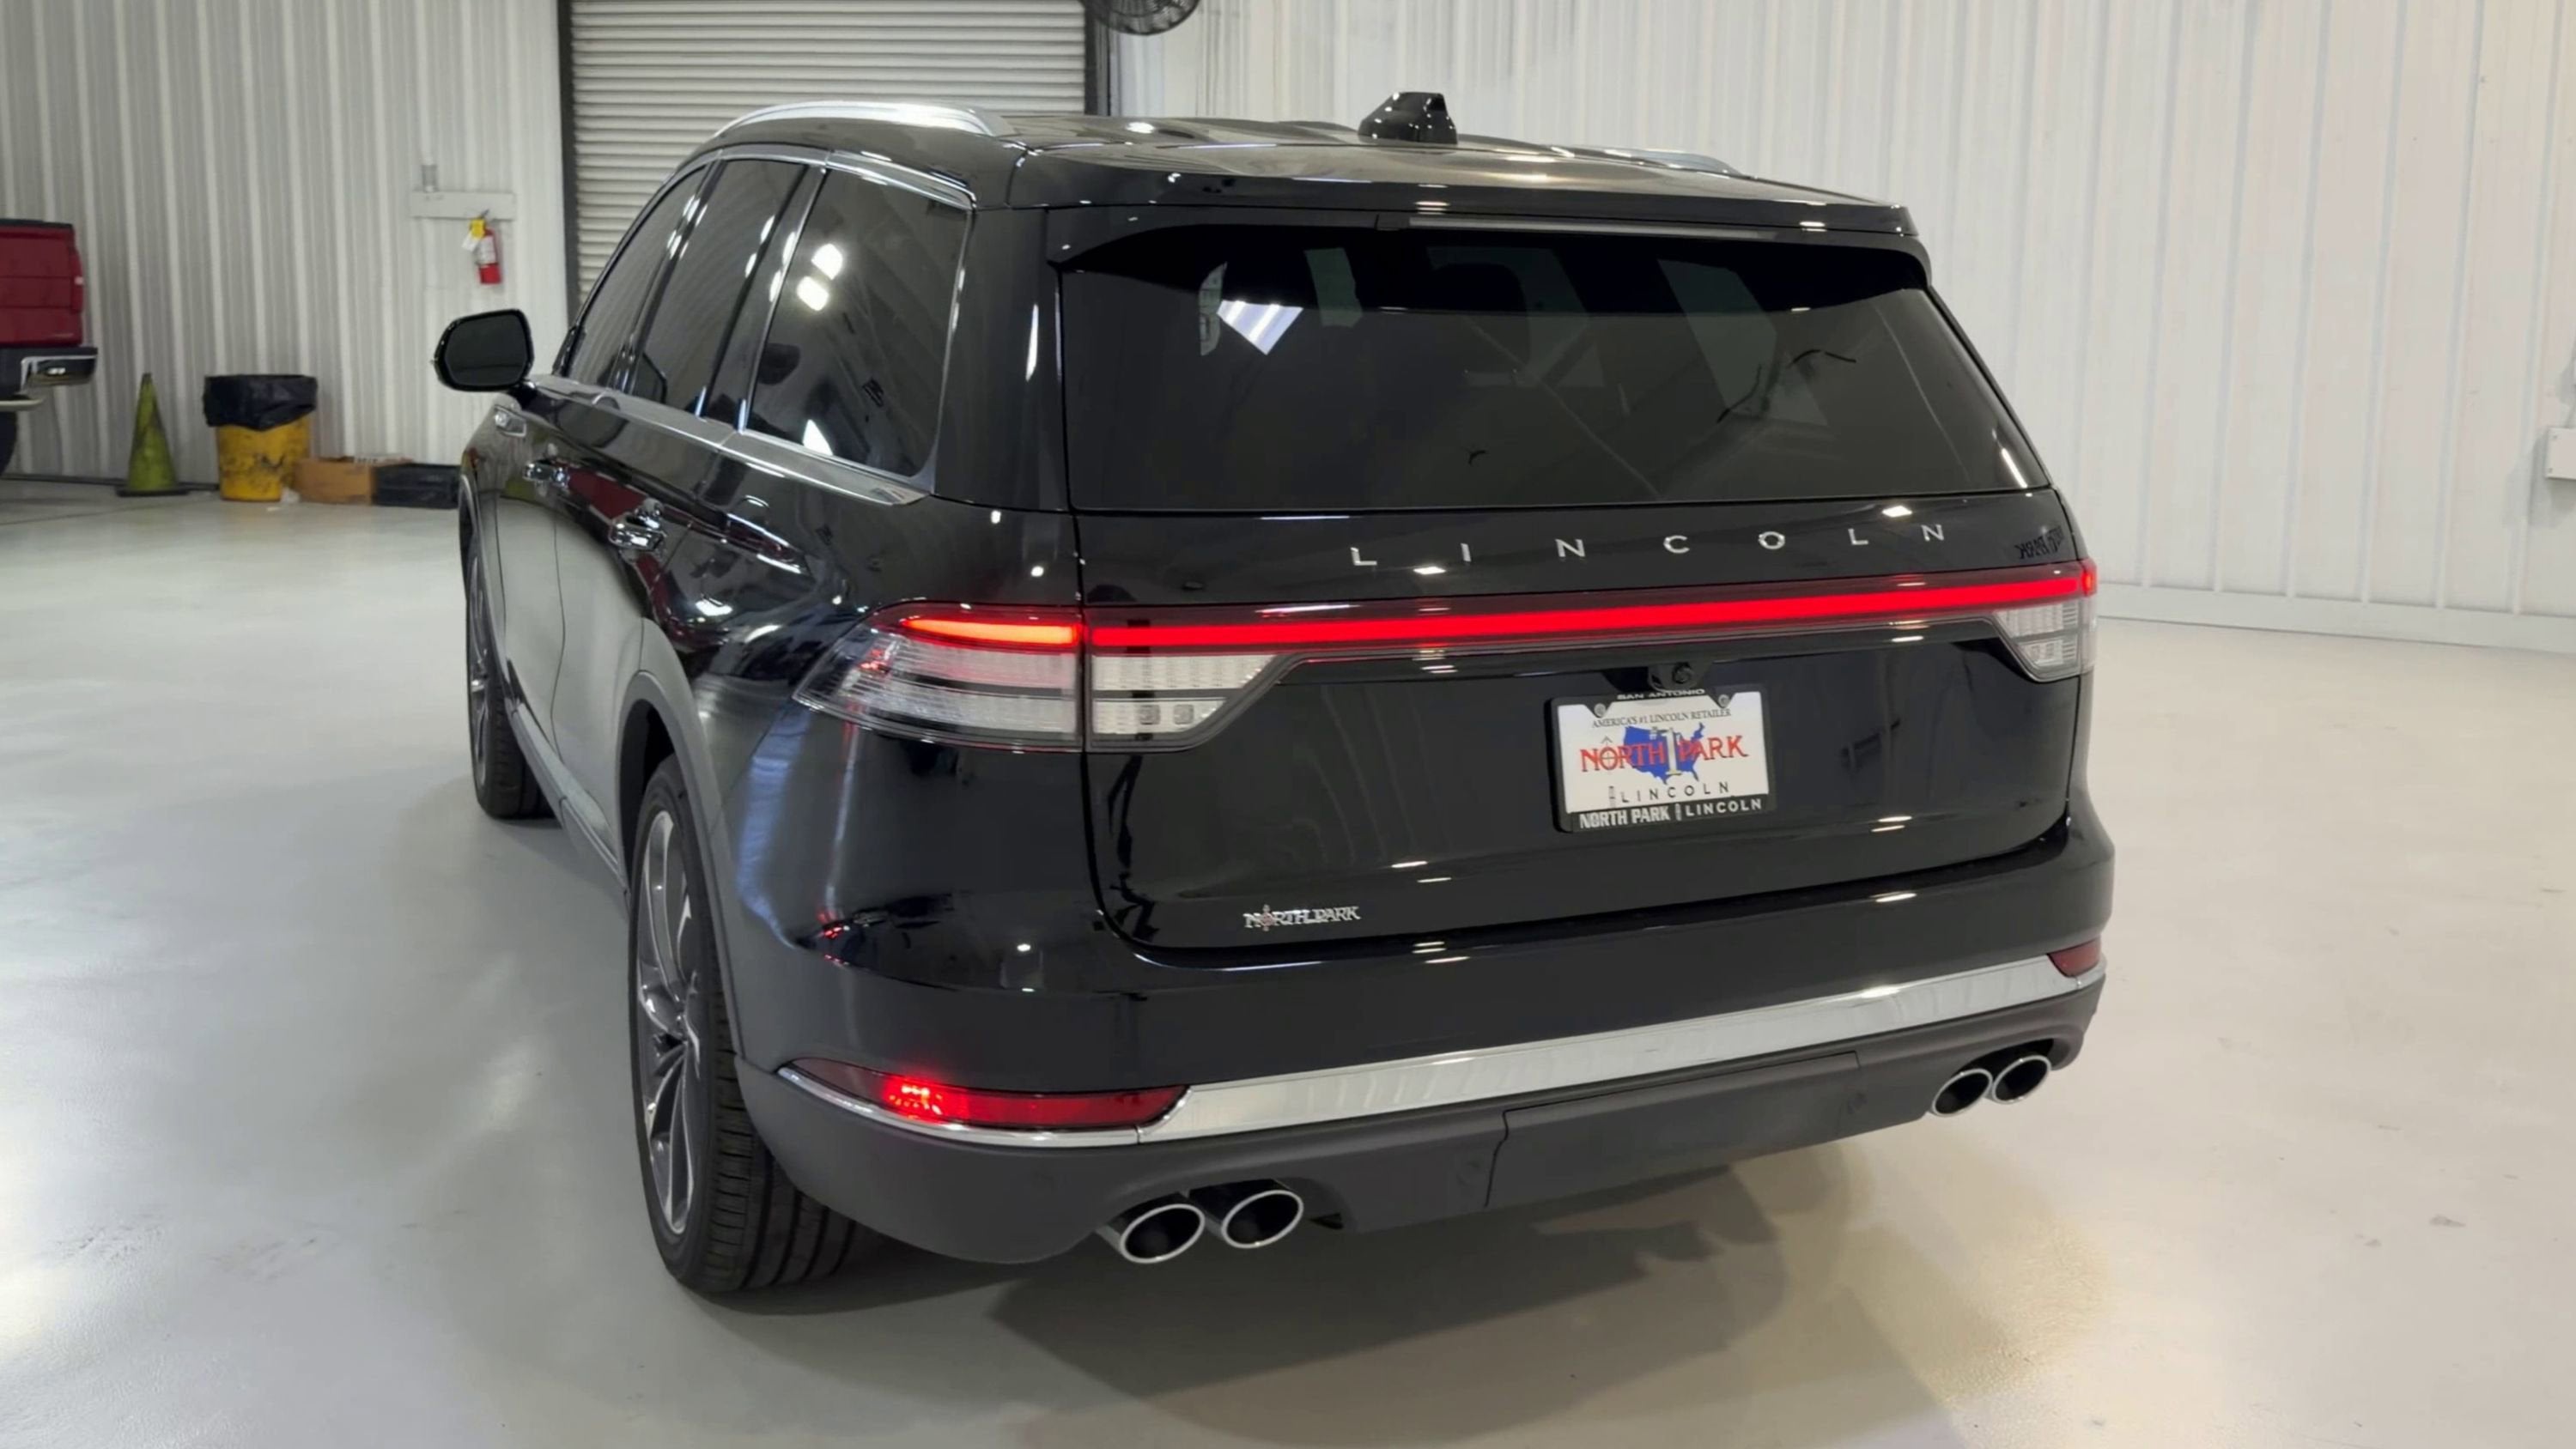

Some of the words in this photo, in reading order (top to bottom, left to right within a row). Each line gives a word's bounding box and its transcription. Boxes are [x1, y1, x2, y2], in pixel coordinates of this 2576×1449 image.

[1350, 522, 1947, 567] LINCOLN
[1649, 688, 1705, 698] ANTONIO
[1592, 716, 1638, 728] AMERICA'S
[1649, 712, 1690, 724] LINCOLN
[1691, 708, 1732, 718] RETAILER
[1580, 742, 1668, 772] NORTH
[1679, 735, 1748, 763] PARK
[1620, 782, 1729, 803] LINCOLN
[1579, 809, 1629, 829] NORTH
[1631, 805, 1670, 823] PARK
[1686, 798, 1762, 817] LINCOLN
